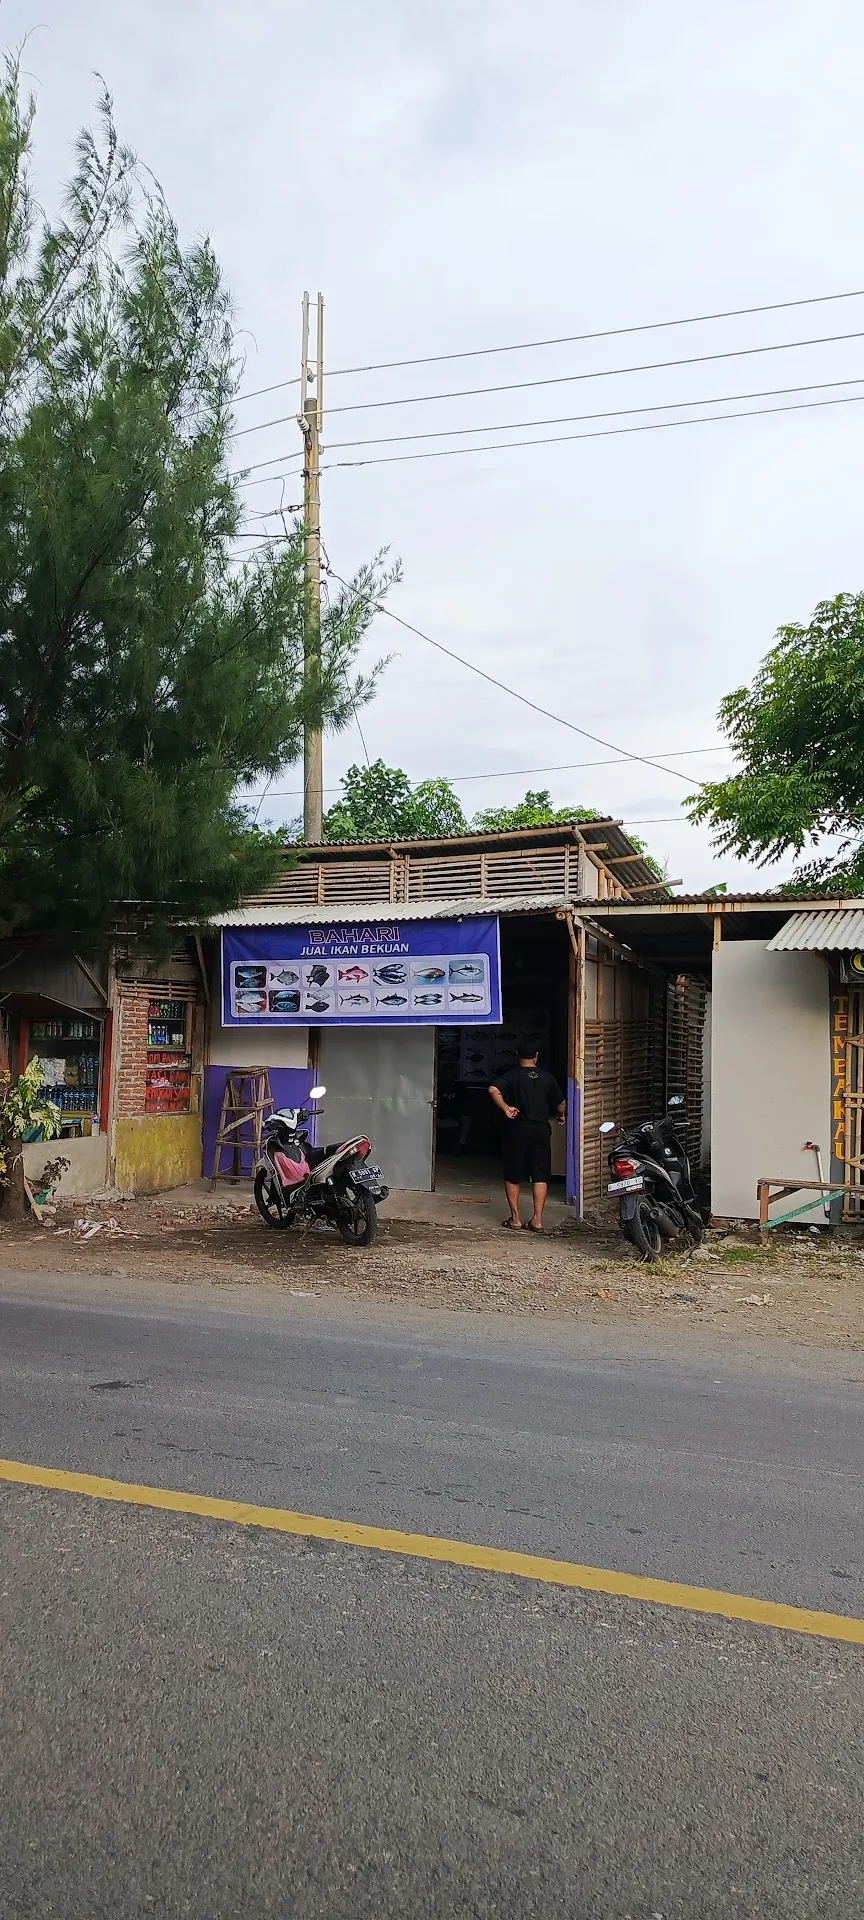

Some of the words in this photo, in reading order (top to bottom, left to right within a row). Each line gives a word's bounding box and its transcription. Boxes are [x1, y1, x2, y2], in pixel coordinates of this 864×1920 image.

[308, 927, 400, 944] BAHARI
[300, 946, 327, 956] JUAL
[331, 945, 358, 955] IKAN
[361, 943, 409, 954] BEKUAN
